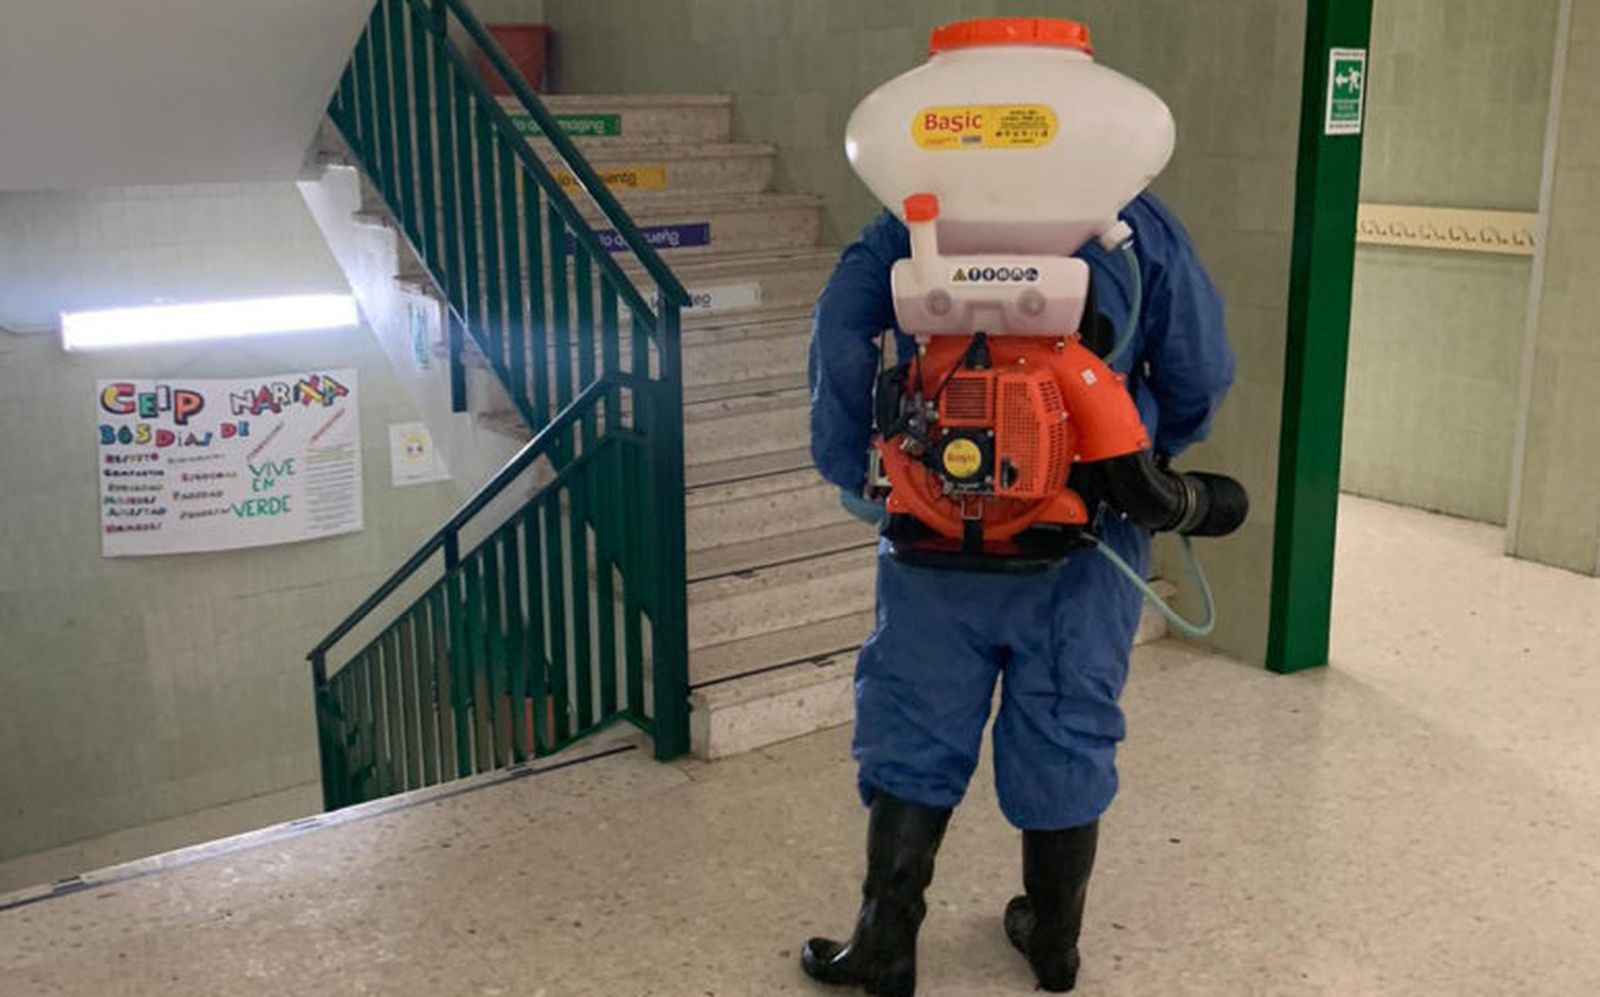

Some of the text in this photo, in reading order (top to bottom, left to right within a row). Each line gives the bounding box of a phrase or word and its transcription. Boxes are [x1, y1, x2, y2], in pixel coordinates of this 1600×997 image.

[924, 112, 982, 132] Basic
[100, 382, 204, 425] CEIP
[220, 420, 250, 439] DE
[248, 457, 297, 476] VIVE
[230, 494, 292, 518] VERDE
